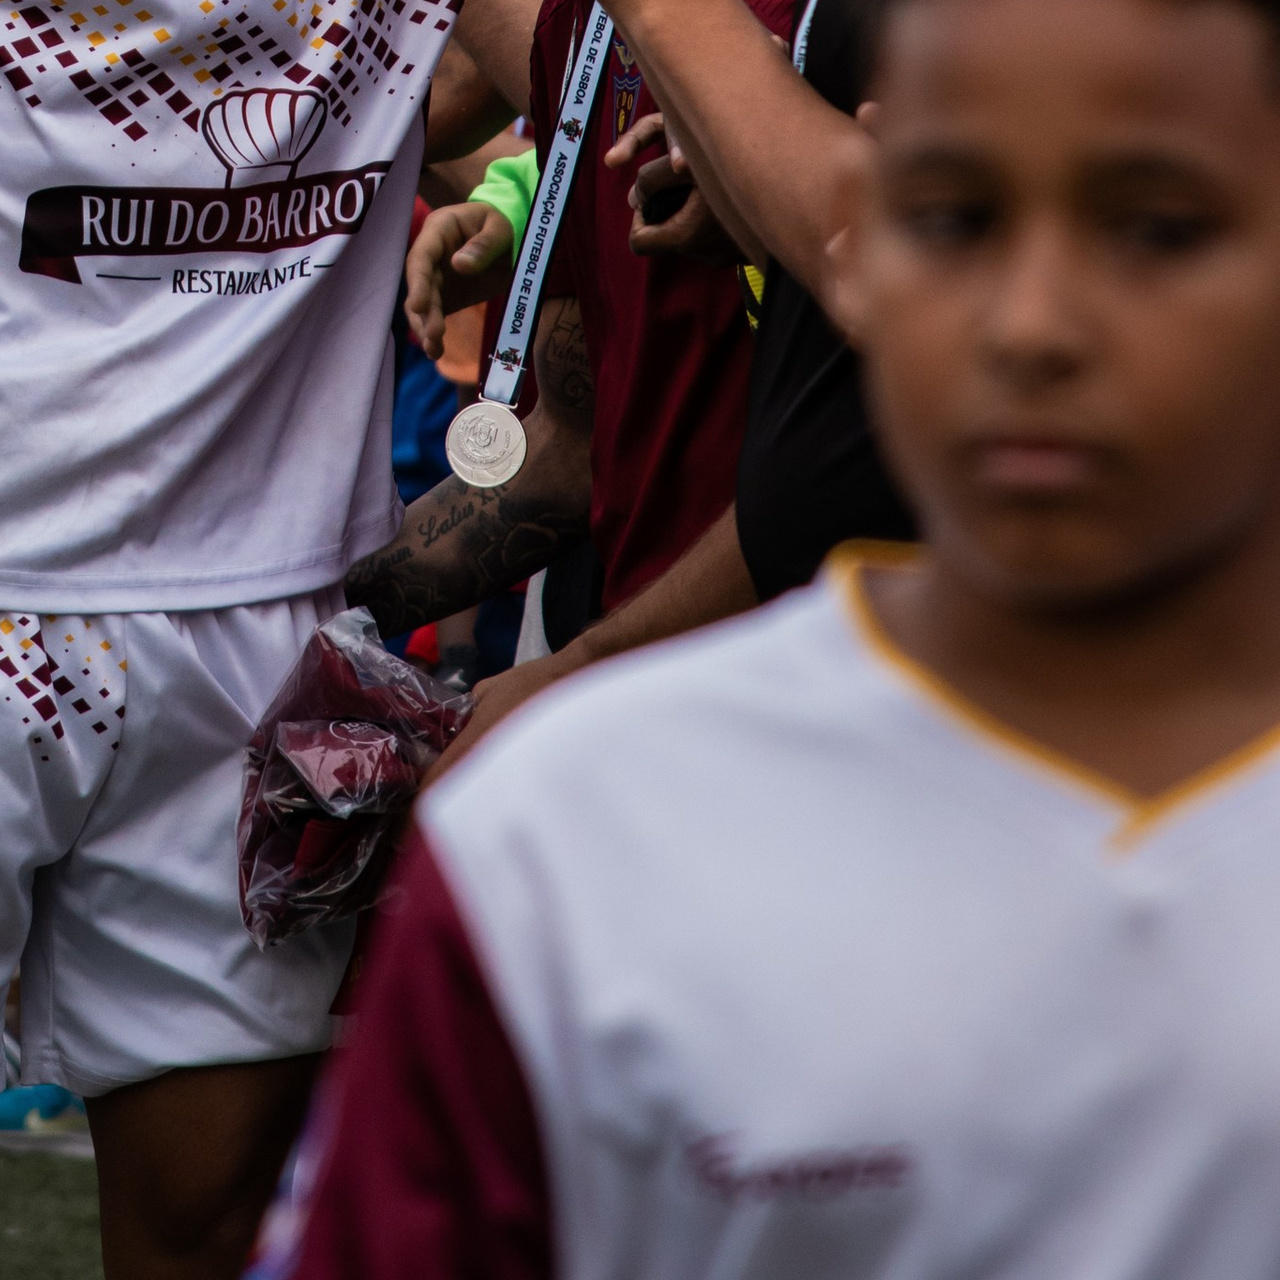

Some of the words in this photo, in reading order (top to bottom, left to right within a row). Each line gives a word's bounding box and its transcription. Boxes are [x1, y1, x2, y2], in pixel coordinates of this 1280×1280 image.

[591, 9, 608, 44] TEBOL
[586, 47, 598, 65] DE
[573, 65, 593, 105] LISBOA
[81, 195, 155, 247] RUI
[164, 198, 231, 247] DO
[236, 170, 389, 243] BARROT
[540, 151, 568, 226] ASSOCIAÇÃO
[525, 226, 548, 276] FUTEBOL
[171, 255, 312, 297] RESTAURANTE
[520, 277, 534, 295] DE
[509, 295, 529, 335] LISBOA
